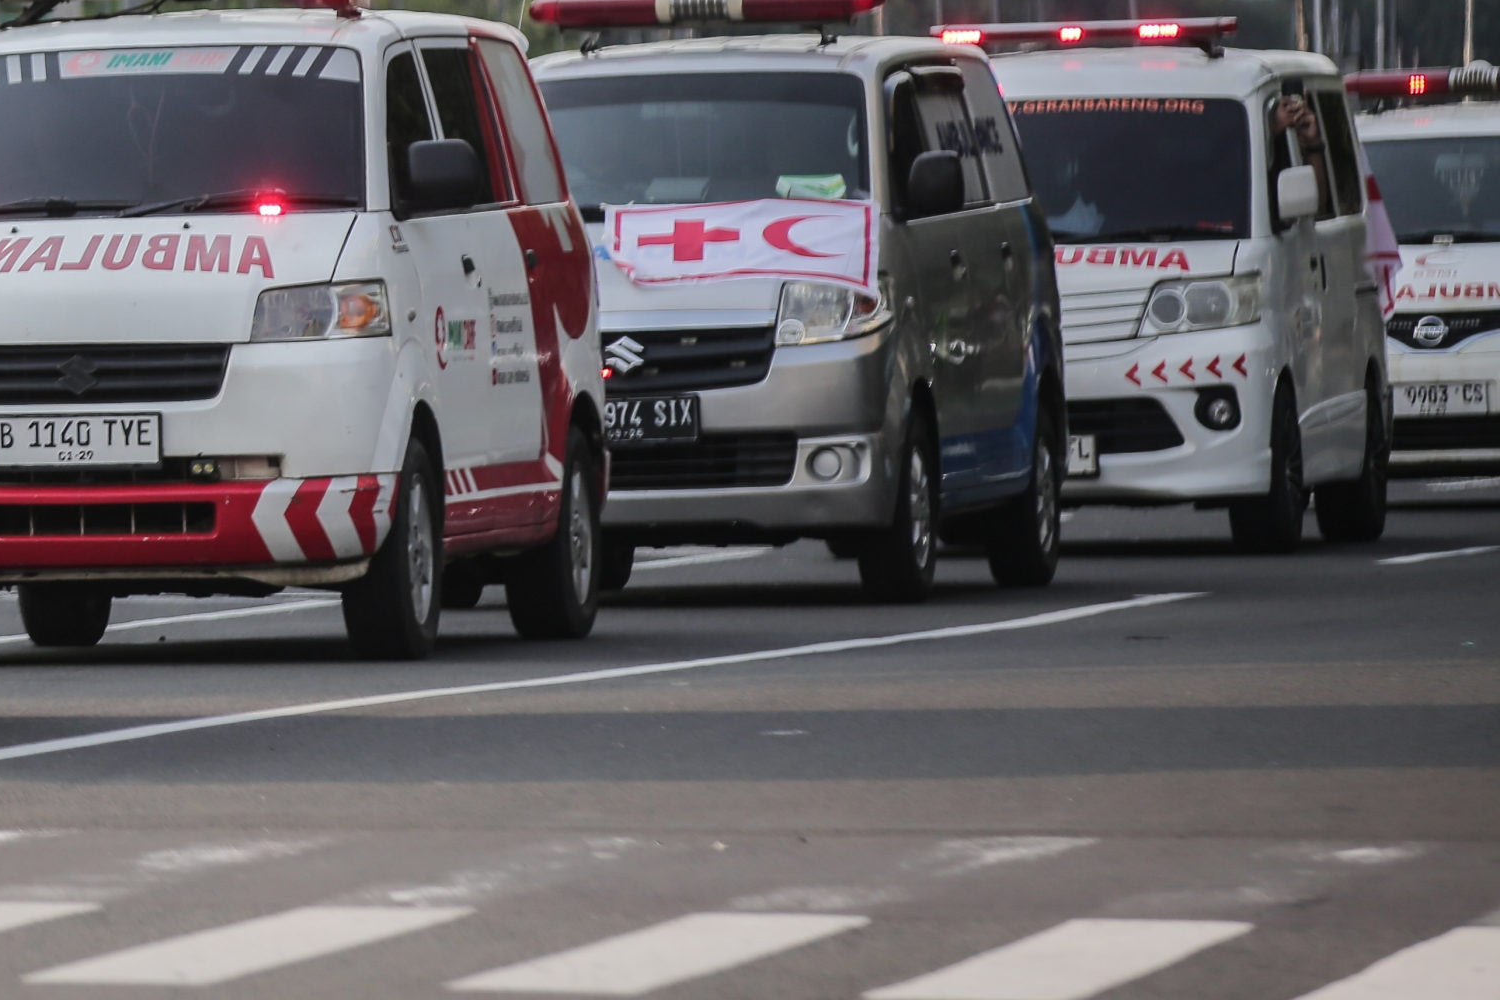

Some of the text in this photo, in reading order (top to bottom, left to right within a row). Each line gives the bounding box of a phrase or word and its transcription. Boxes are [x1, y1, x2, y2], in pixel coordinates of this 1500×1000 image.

[107, 51, 174, 68] IMANI
[654, 400, 692, 427] SIX
[0, 419, 151, 449] B 1140 TYE
